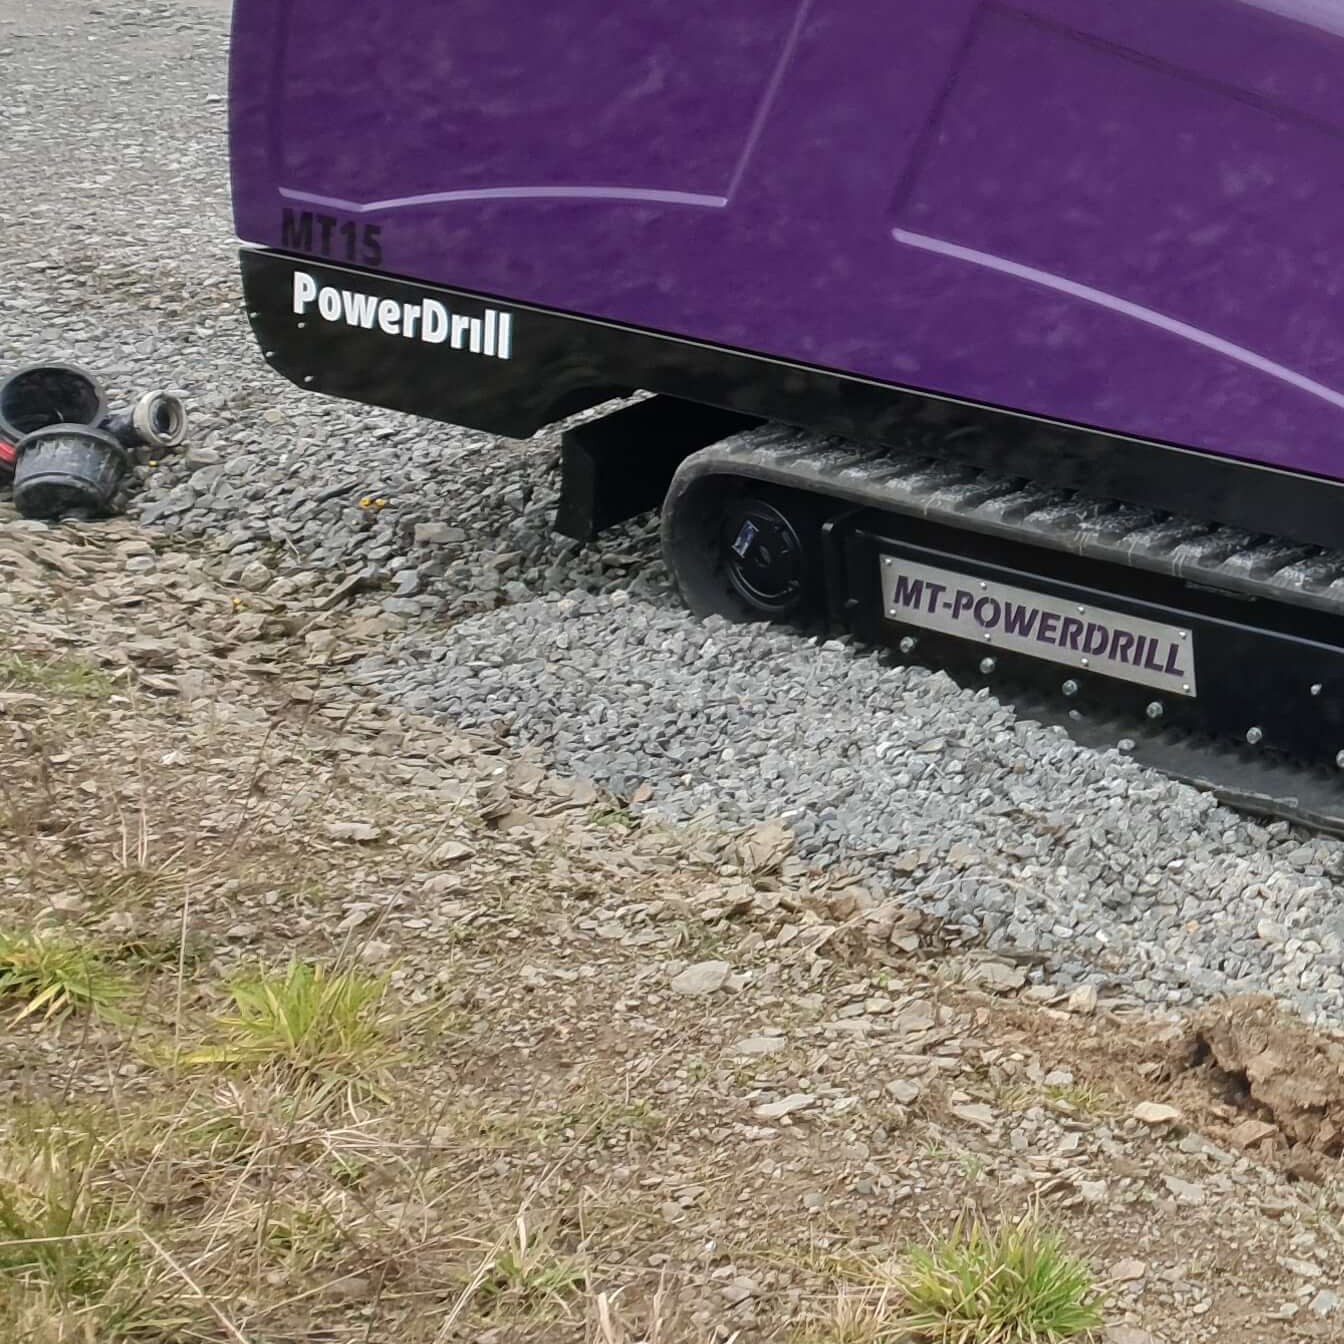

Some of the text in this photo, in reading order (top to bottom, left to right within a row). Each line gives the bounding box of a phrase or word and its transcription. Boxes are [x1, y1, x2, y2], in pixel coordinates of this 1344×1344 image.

[280, 207, 383, 267] MT15
[292, 271, 513, 359] PowerDrill
[893, 573, 1186, 678] MT-POWERDRILL
